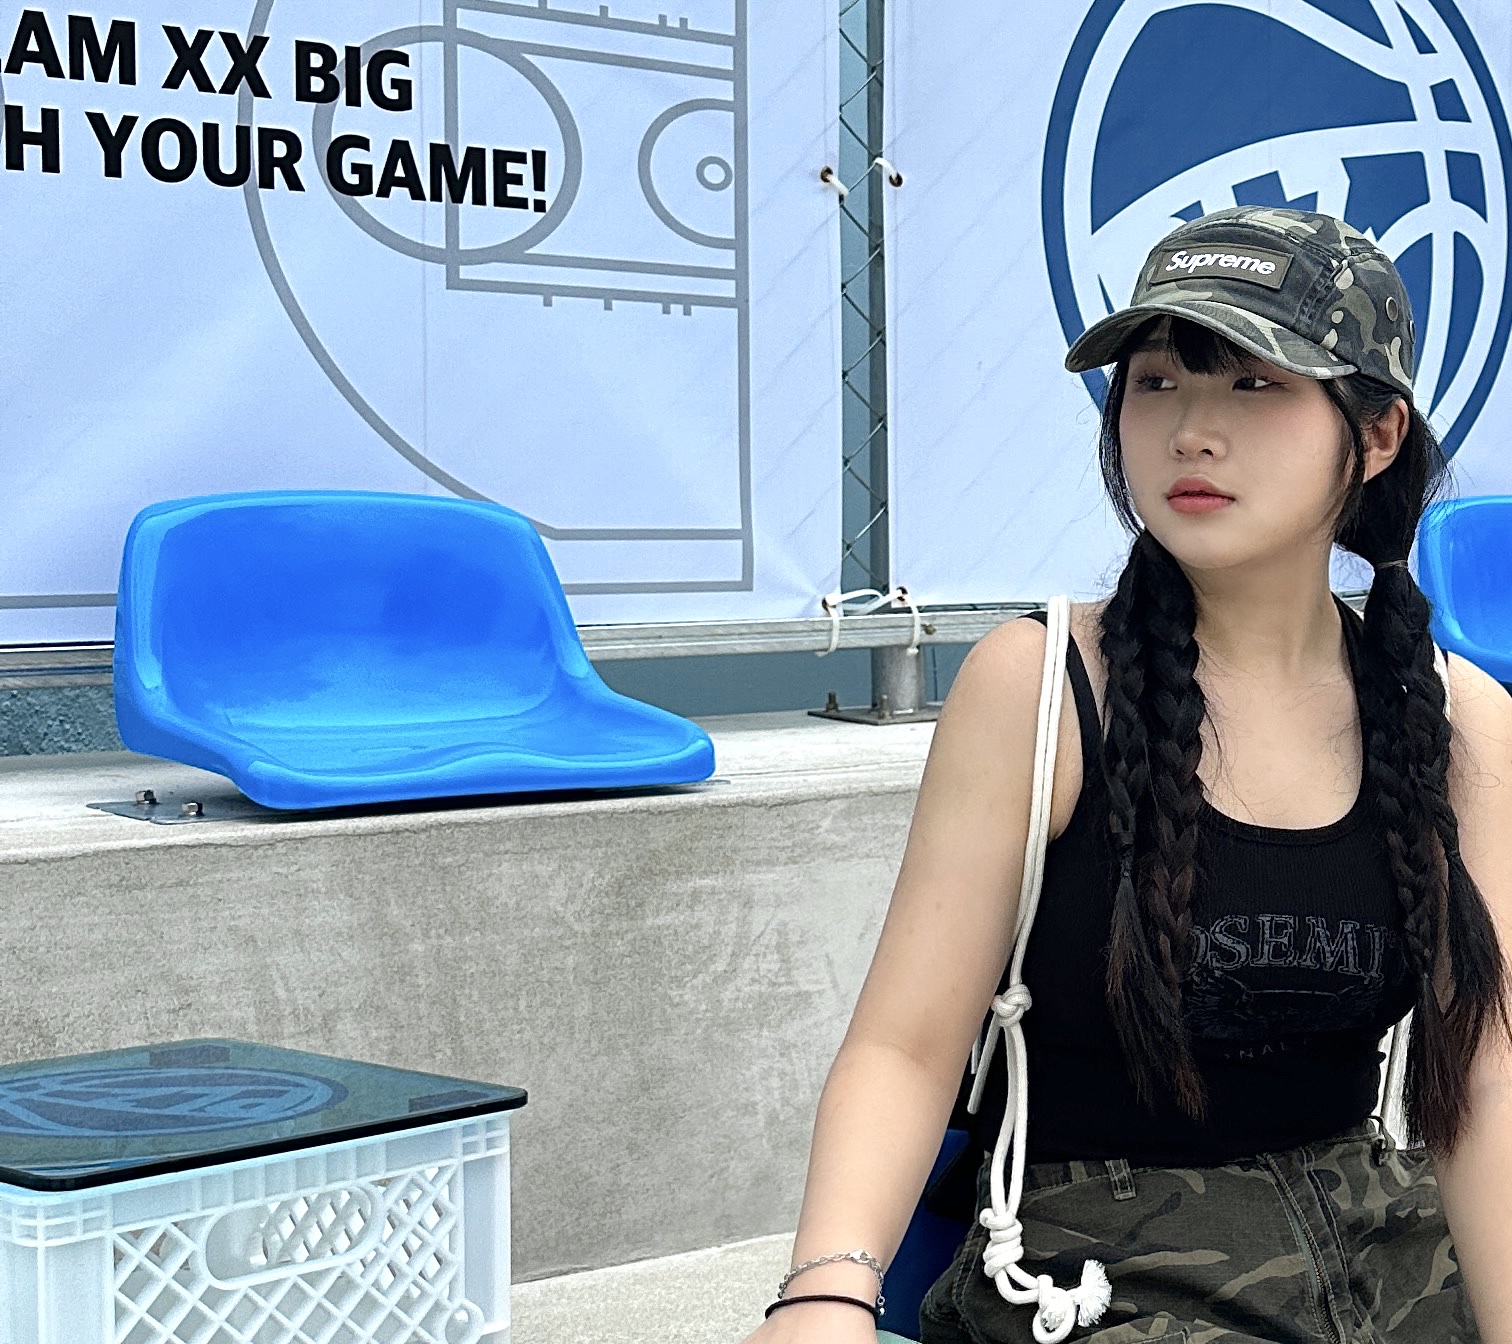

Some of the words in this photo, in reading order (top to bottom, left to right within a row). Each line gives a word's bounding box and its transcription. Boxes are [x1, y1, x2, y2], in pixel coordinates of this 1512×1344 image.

[0, 9, 137, 86] AM
[161, 24, 272, 99] XX
[294, 39, 413, 112] BIG
[84, 111, 306, 192] YOUR
[326, 134, 548, 213] GAME!
[1165, 250, 1276, 275] Supreme
